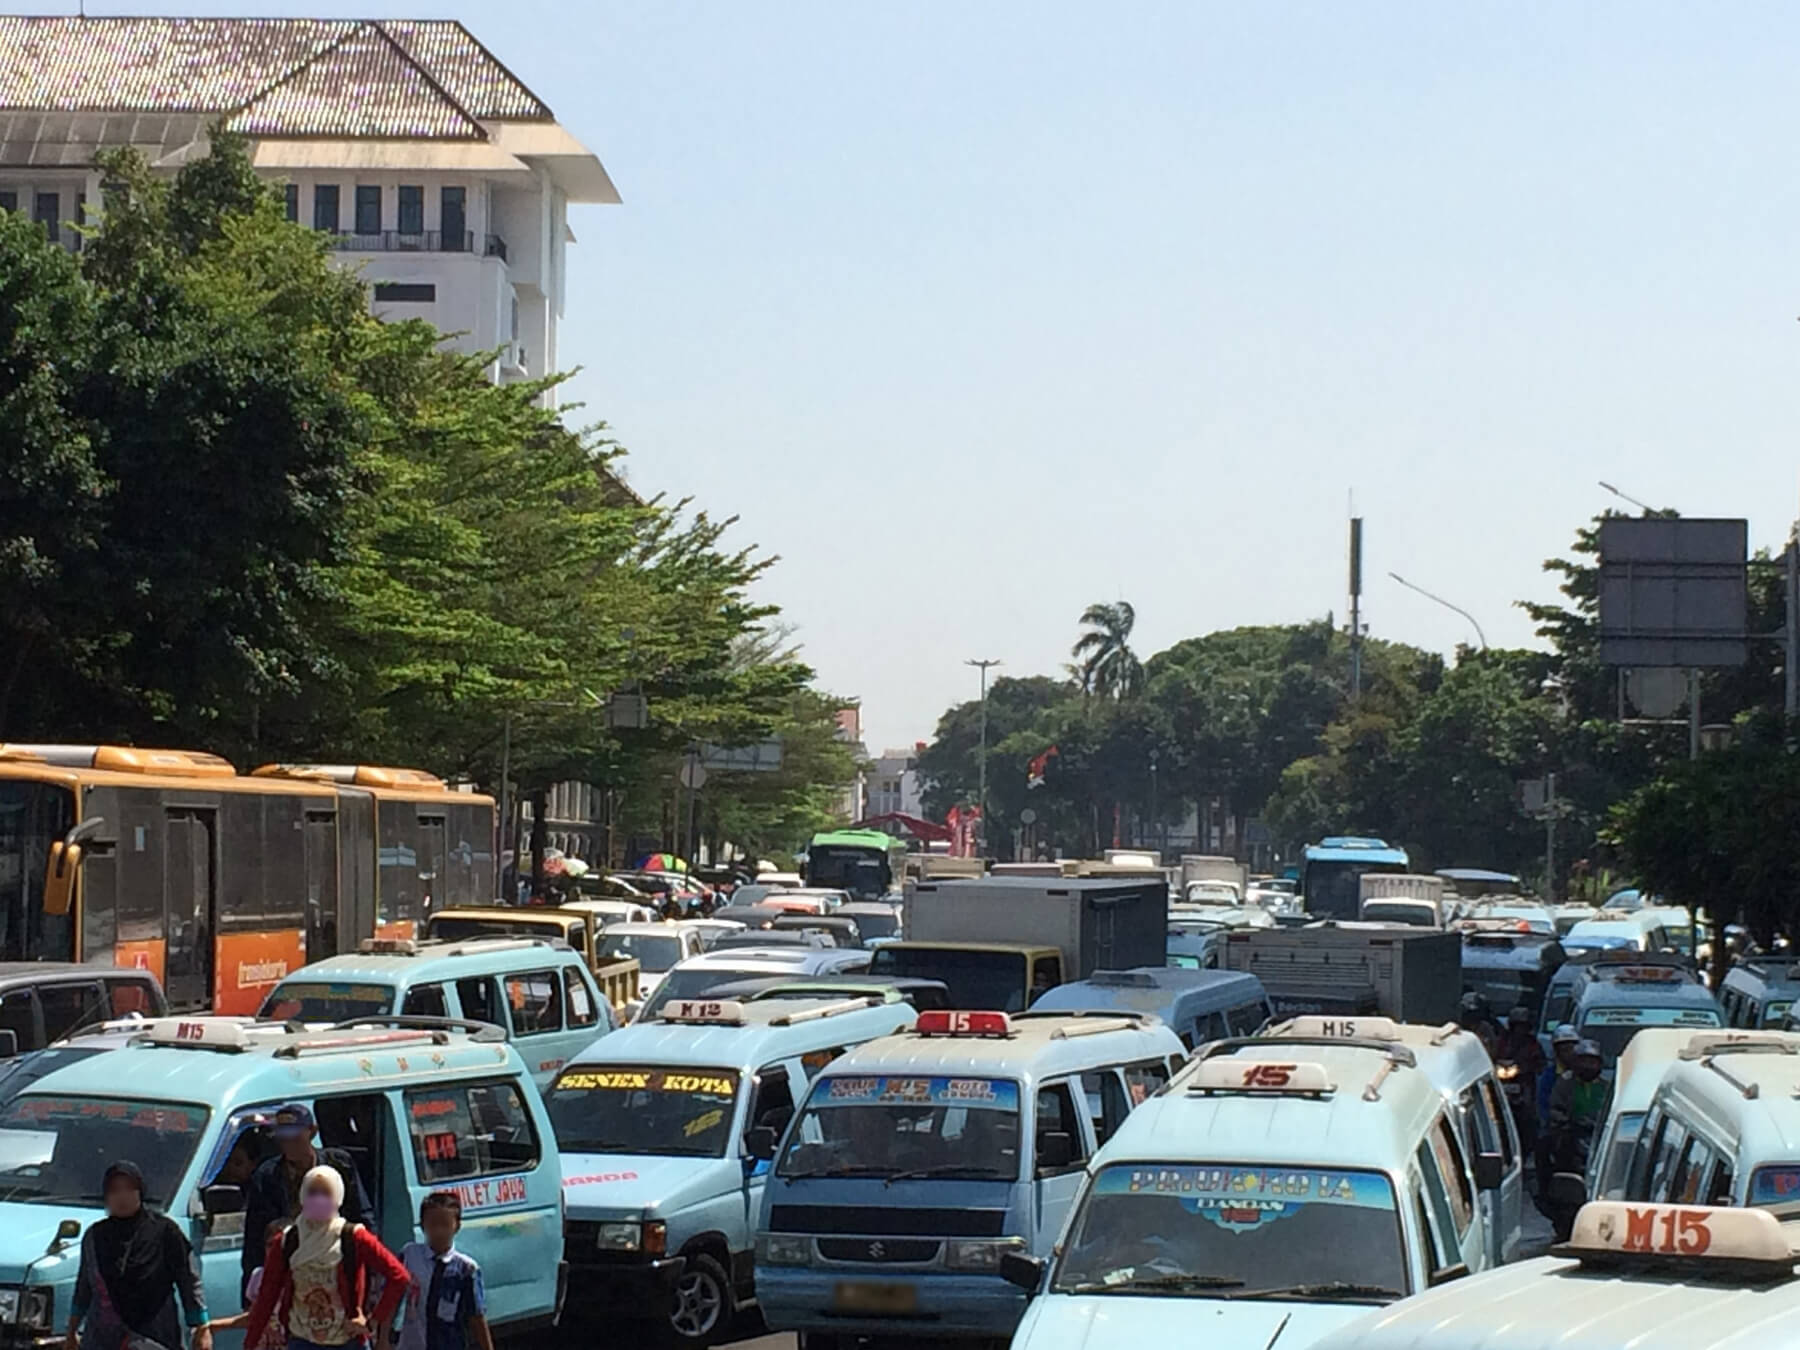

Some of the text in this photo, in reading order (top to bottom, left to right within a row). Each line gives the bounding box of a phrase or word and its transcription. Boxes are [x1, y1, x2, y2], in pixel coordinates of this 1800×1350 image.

[177, 1022, 205, 1040] M15
[949, 1012, 971, 1032] 15
[662, 1075, 732, 1094] KOTA
[1242, 1064, 1298, 1086] 15
[1622, 1207, 1713, 1255] M15
